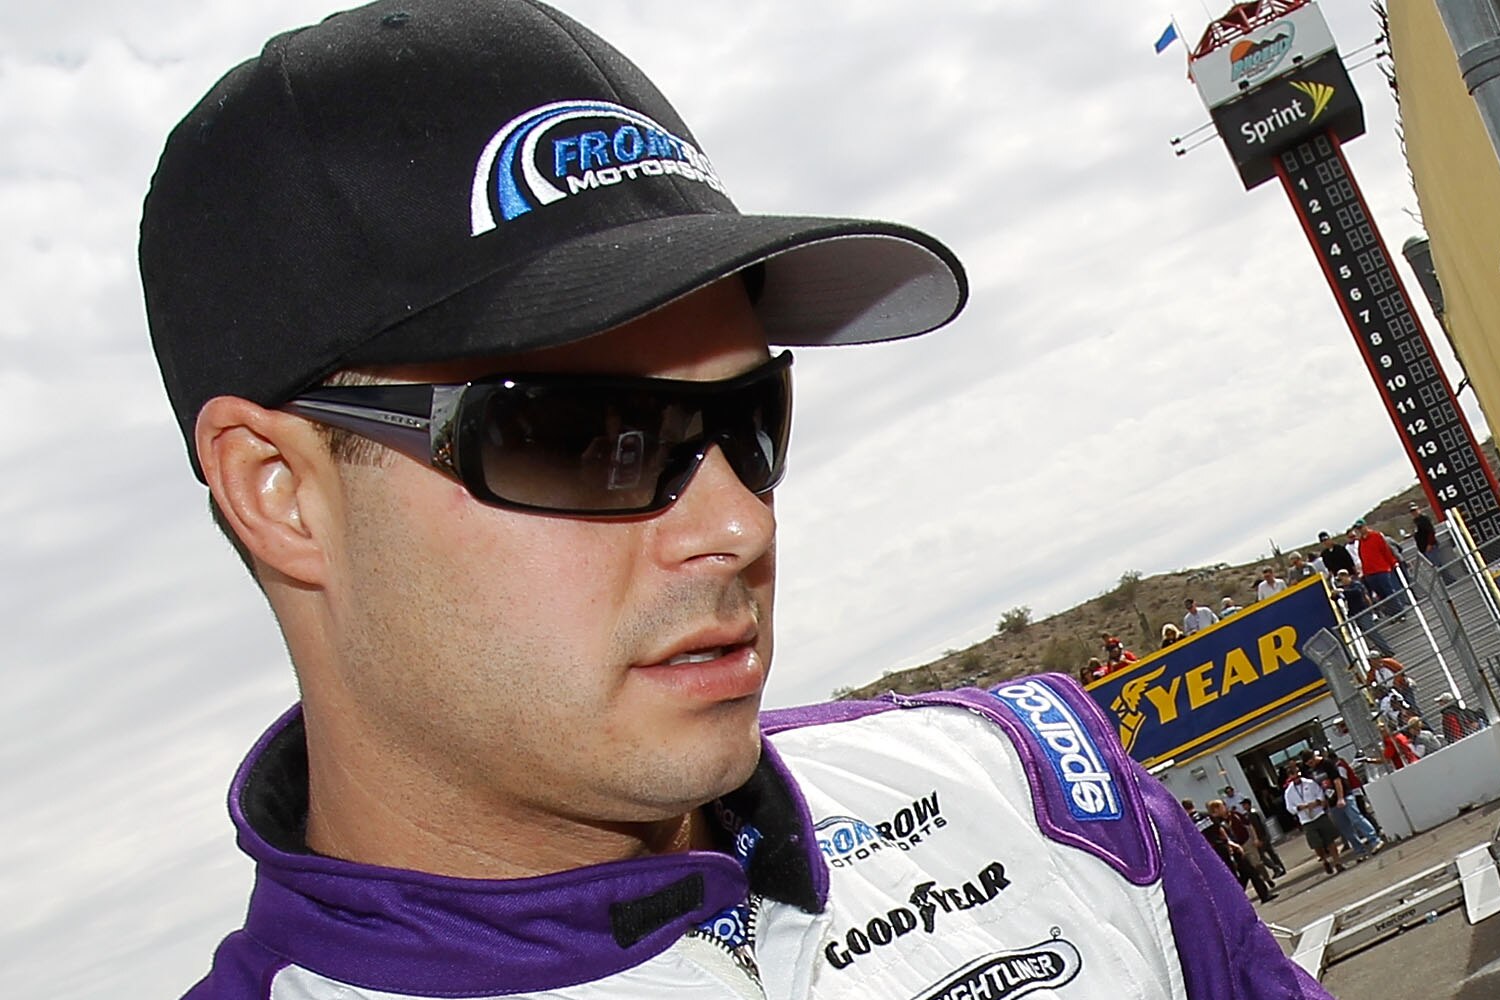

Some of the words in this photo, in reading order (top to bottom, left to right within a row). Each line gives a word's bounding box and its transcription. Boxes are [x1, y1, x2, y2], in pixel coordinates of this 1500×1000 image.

[1240, 98, 1307, 145] Sprint
[1299, 177, 1310, 190] 1
[1309, 199, 1322, 213] 2
[1319, 221, 1331, 235] 3
[1330, 243, 1342, 257] 4
[1339, 266, 1351, 279] 5
[1350, 288, 1362, 301] 6
[1359, 310, 1371, 323] 7
[1370, 332, 1383, 346] 8
[1380, 355, 1392, 368] 9
[1386, 375, 1407, 391] 10
[1397, 397, 1416, 413] 11
[1407, 419, 1428, 435] 12
[1417, 441, 1438, 457] 13
[1427, 463, 1448, 479] 14
[1437, 485, 1458, 501] 15
[1144, 625, 1302, 725] YEAR
[998, 684, 1112, 814] sparco
[875, 790, 940, 841] ROW
[825, 861, 1012, 969] GOODYEAR
